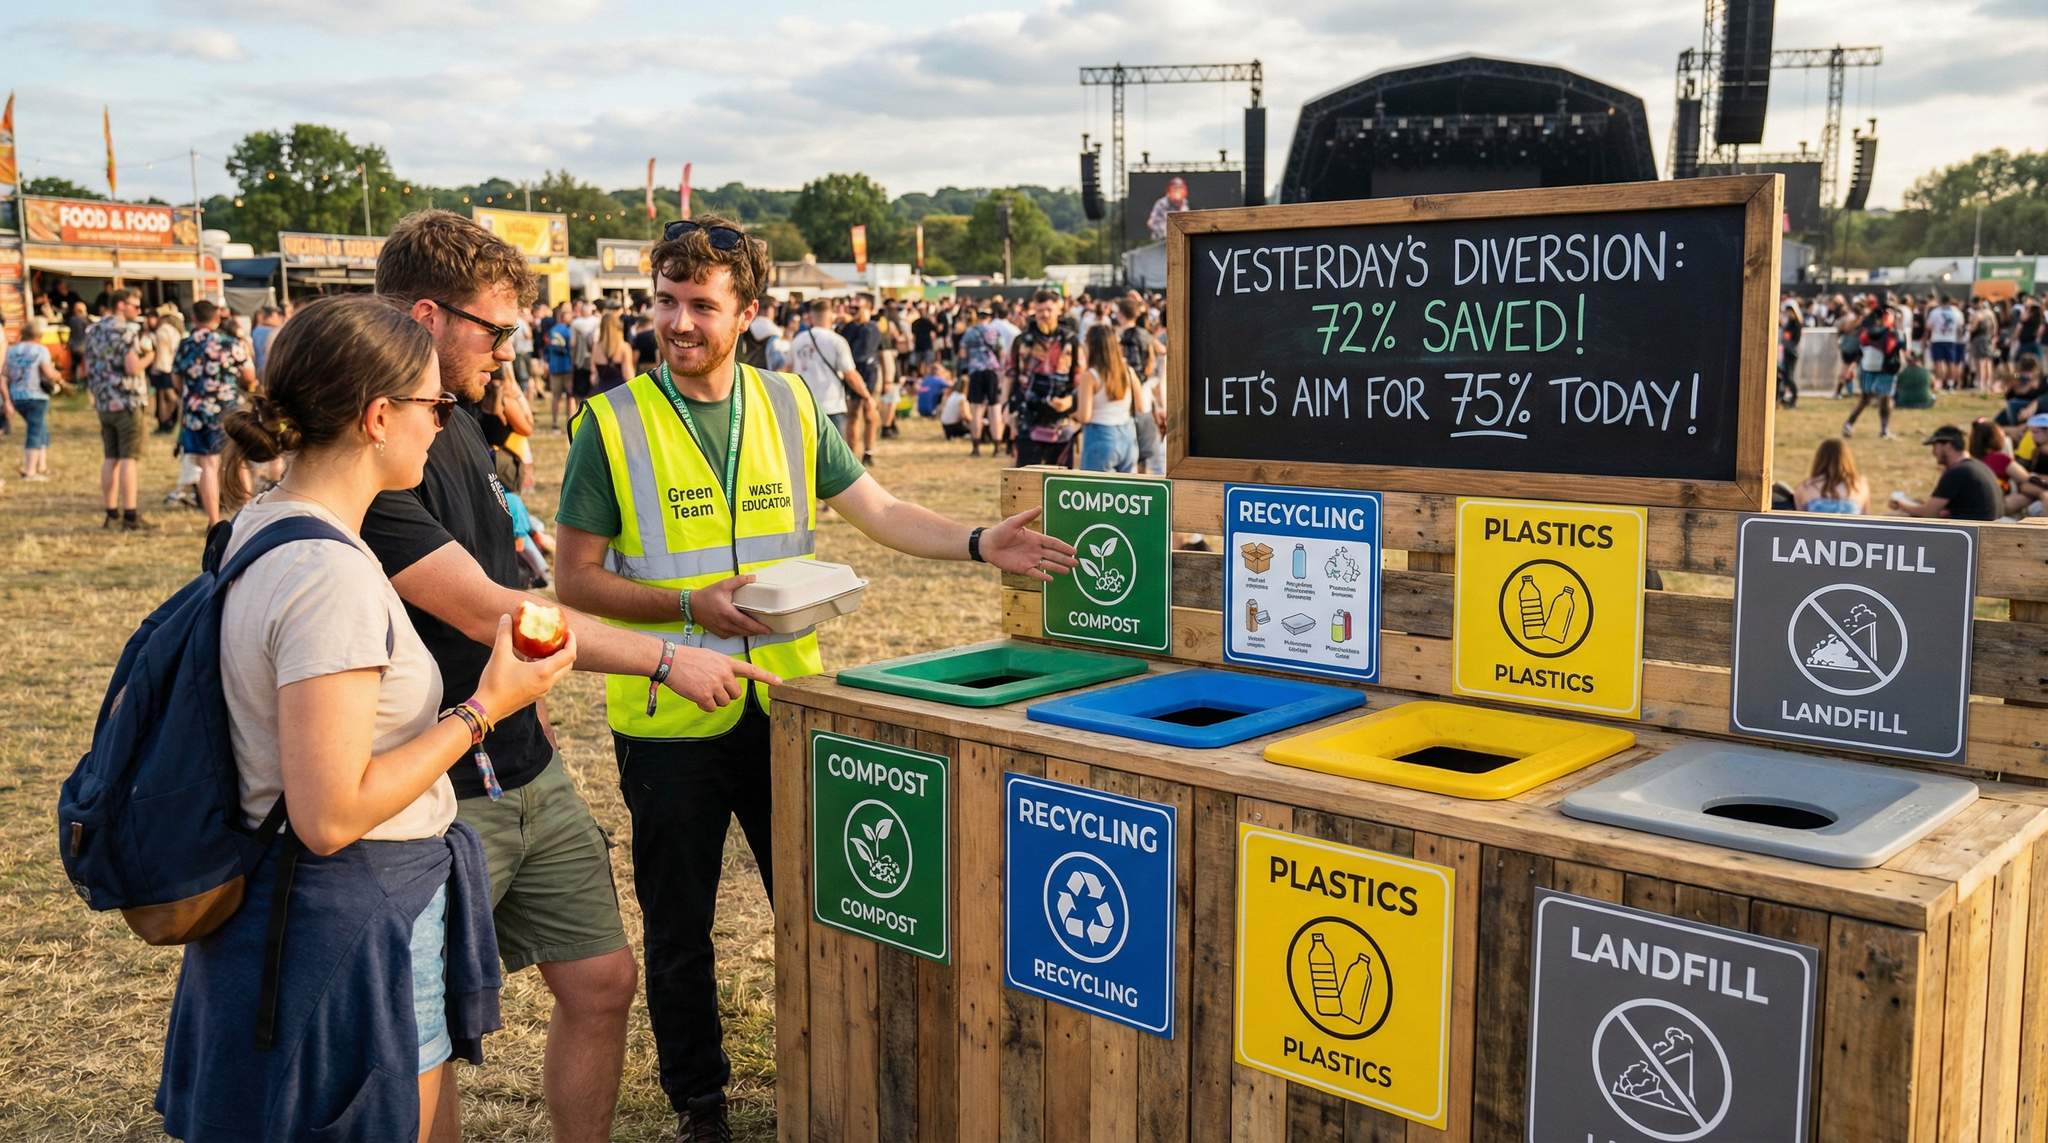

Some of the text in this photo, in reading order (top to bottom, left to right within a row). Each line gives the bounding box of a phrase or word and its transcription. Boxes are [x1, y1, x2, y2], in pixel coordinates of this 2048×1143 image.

[60, 206, 171, 233] FOOD & FOOD
[1209, 230, 1685, 296] YESTERDAY'S DIVERSION:
[1312, 293, 1586, 356] 72% SAVED!
[1204, 370, 1700, 435] LET'S AIM FOR 75% TODAY!
[667, 486, 714, 503] Green
[742, 496, 791, 512] EDUCATOR
[748, 482, 784, 497] WASTE
[1058, 489, 1153, 516] COMPOST
[671, 503, 714, 520] Team
[1239, 501, 1365, 532] RECYCLING
[1484, 518, 1614, 549] PLASTICS
[1772, 536, 1936, 574] LANDFILL
[1068, 611, 1141, 635] COMPOST
[1495, 663, 1595, 694] PLASTICS
[1781, 700, 1908, 735] LANDFILL
[828, 753, 929, 798] COMPOST
[1019, 798, 1158, 853] RECYCLING
[1269, 856, 1418, 917] PLASTICS
[840, 897, 918, 937] COMPOST
[1033, 957, 1139, 1009] RECYCLING
[1571, 926, 1769, 1005] LANDFILL
[1282, 1035, 1392, 1089] PLASTICS
